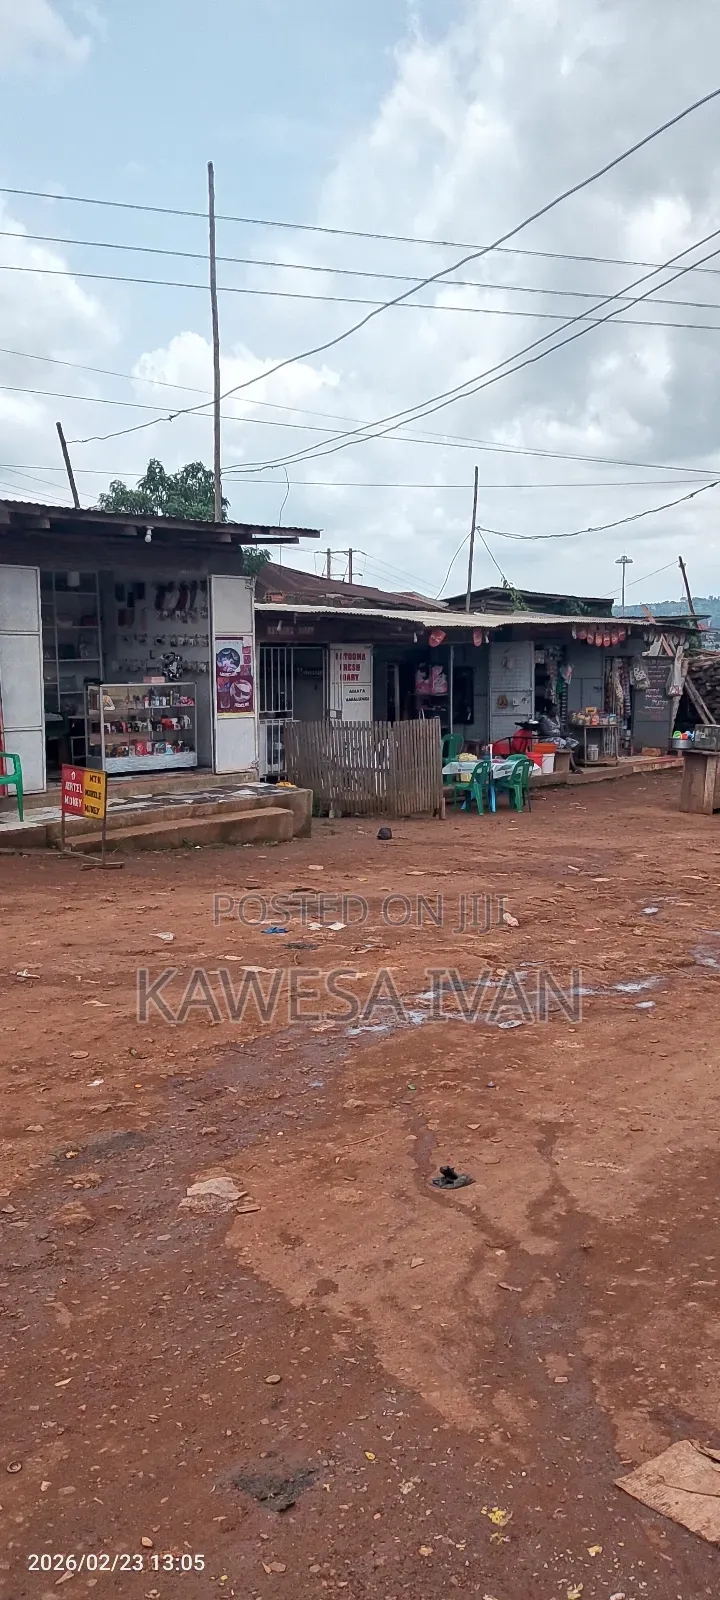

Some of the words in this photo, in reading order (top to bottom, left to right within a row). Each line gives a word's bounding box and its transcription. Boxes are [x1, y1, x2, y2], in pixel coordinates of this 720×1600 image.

[64, 781, 83, 794] AIRTEL
[64, 795, 83, 807] MONEY
[84, 804, 100, 815] MONEY
